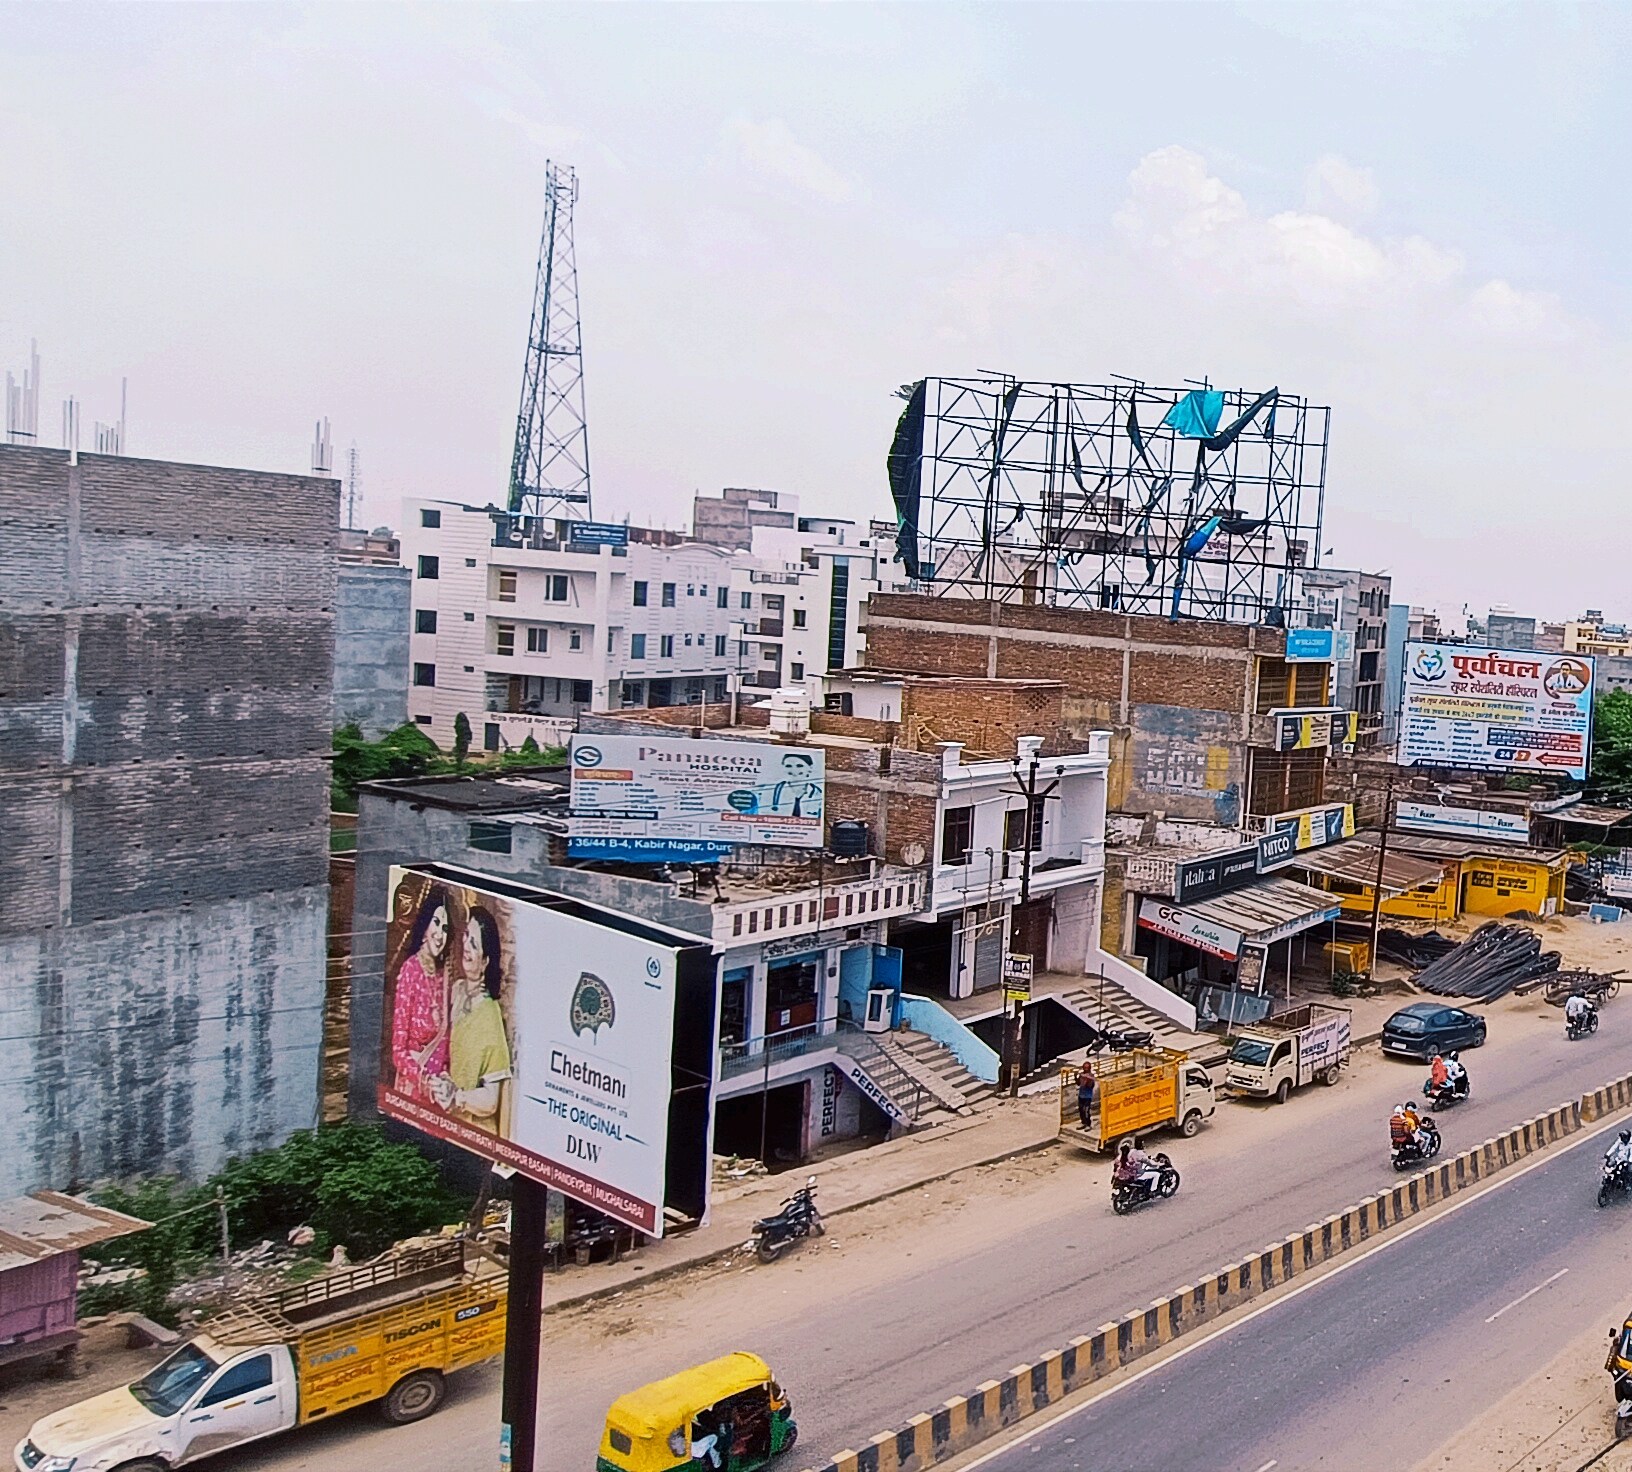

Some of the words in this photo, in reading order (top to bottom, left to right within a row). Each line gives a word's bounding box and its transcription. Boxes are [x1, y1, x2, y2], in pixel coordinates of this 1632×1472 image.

[690, 764, 761, 774] HOSPITAL
[634, 840, 666, 849] Kabir
[668, 841, 704, 852] Nagar,
[550, 1049, 626, 1098] Chetmani
[821, 1068, 835, 1137] PERFECT
[851, 1067, 903, 1119] PERFECT
[548, 1097, 567, 1119] THE
[570, 1107, 622, 1141] ORIGINAL
[566, 1134, 601, 1163] DLW
[384, 1318, 441, 1344] TISCON
